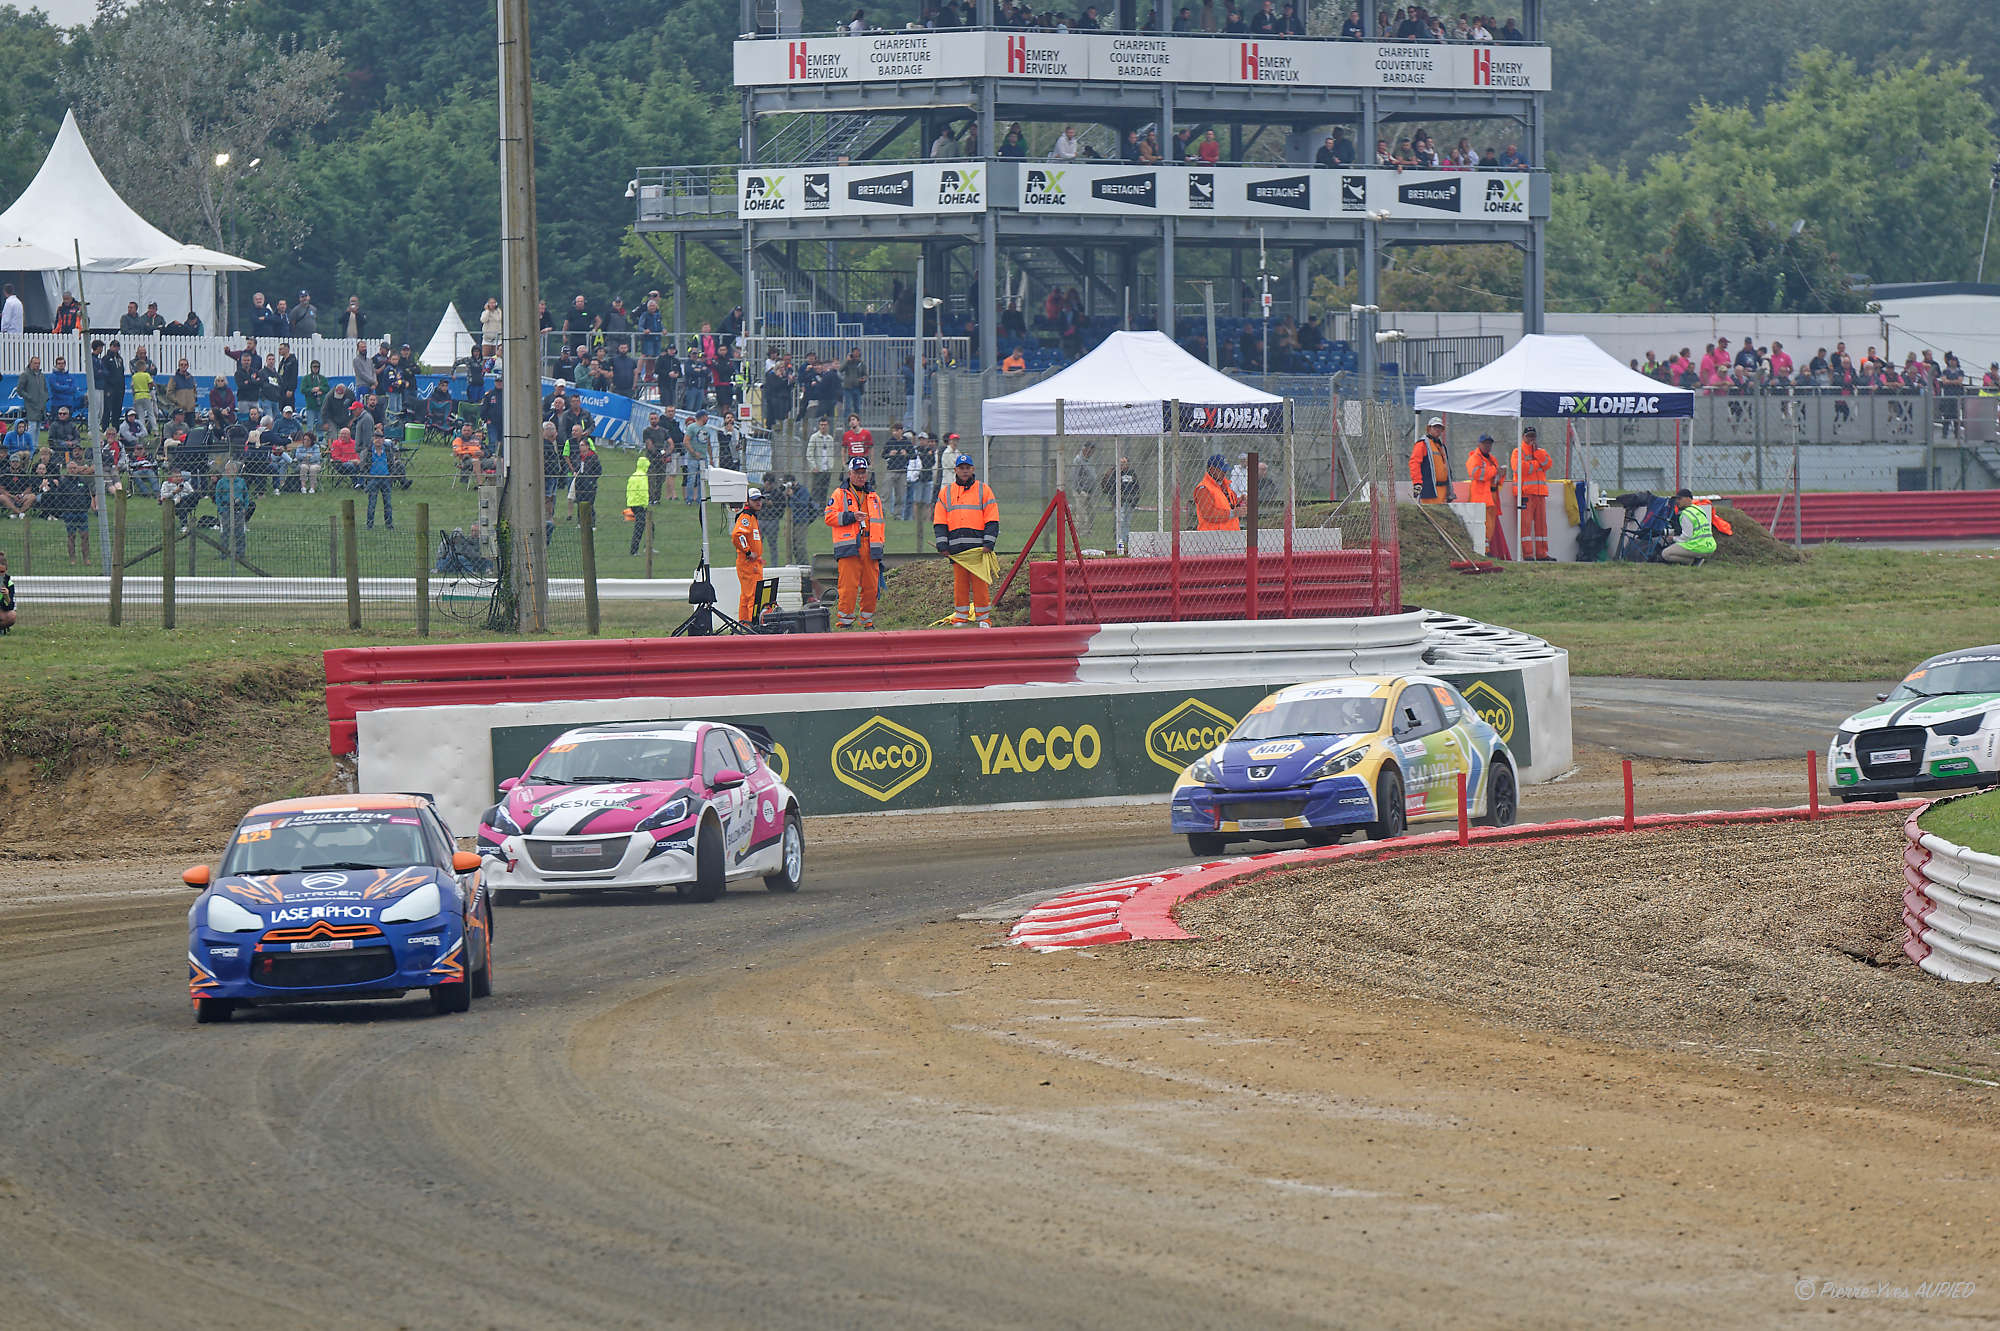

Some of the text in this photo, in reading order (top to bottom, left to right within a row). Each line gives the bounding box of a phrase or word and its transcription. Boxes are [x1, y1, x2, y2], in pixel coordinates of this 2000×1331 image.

[873, 38, 927, 50] CHARPENTE
[1113, 40, 1166, 51] CHARPENTE
[870, 51, 931, 63] COUVERTURE
[1109, 53, 1170, 64] COUVERTURE
[1379, 47, 1430, 59] CHARPENTE
[878, 63, 923, 76] BARDAGE
[1118, 66, 1162, 76] BARDAGE
[1375, 59, 1433, 71] COUVERTURE
[1383, 71, 1425, 84] BARDAGE
[857, 184, 903, 195] BRETAGNE
[1101, 184, 1145, 195] BRETAGNE
[1256, 187, 1300, 197] BRETAGNE
[1408, 189, 1451, 200] BRETAGNE
[938, 192, 980, 204] LOHEAC
[1024, 194, 1066, 205] LOHEAC
[744, 199, 785, 210] LOHEAC
[1484, 202, 1523, 213] LOHEAC
[580, 395, 605, 407] TAGNE
[1588, 397, 1660, 413] LOHEAC
[1214, 407, 1269, 428] LOHEAC
[1161, 726, 1228, 753] YACCO
[970, 724, 1101, 774] YACCO
[1255, 743, 1297, 755] NAPA
[847, 744, 917, 771] YACCO
[287, 818, 371, 827] PERFORMANCE
[293, 813, 392, 823] GUILLERM
